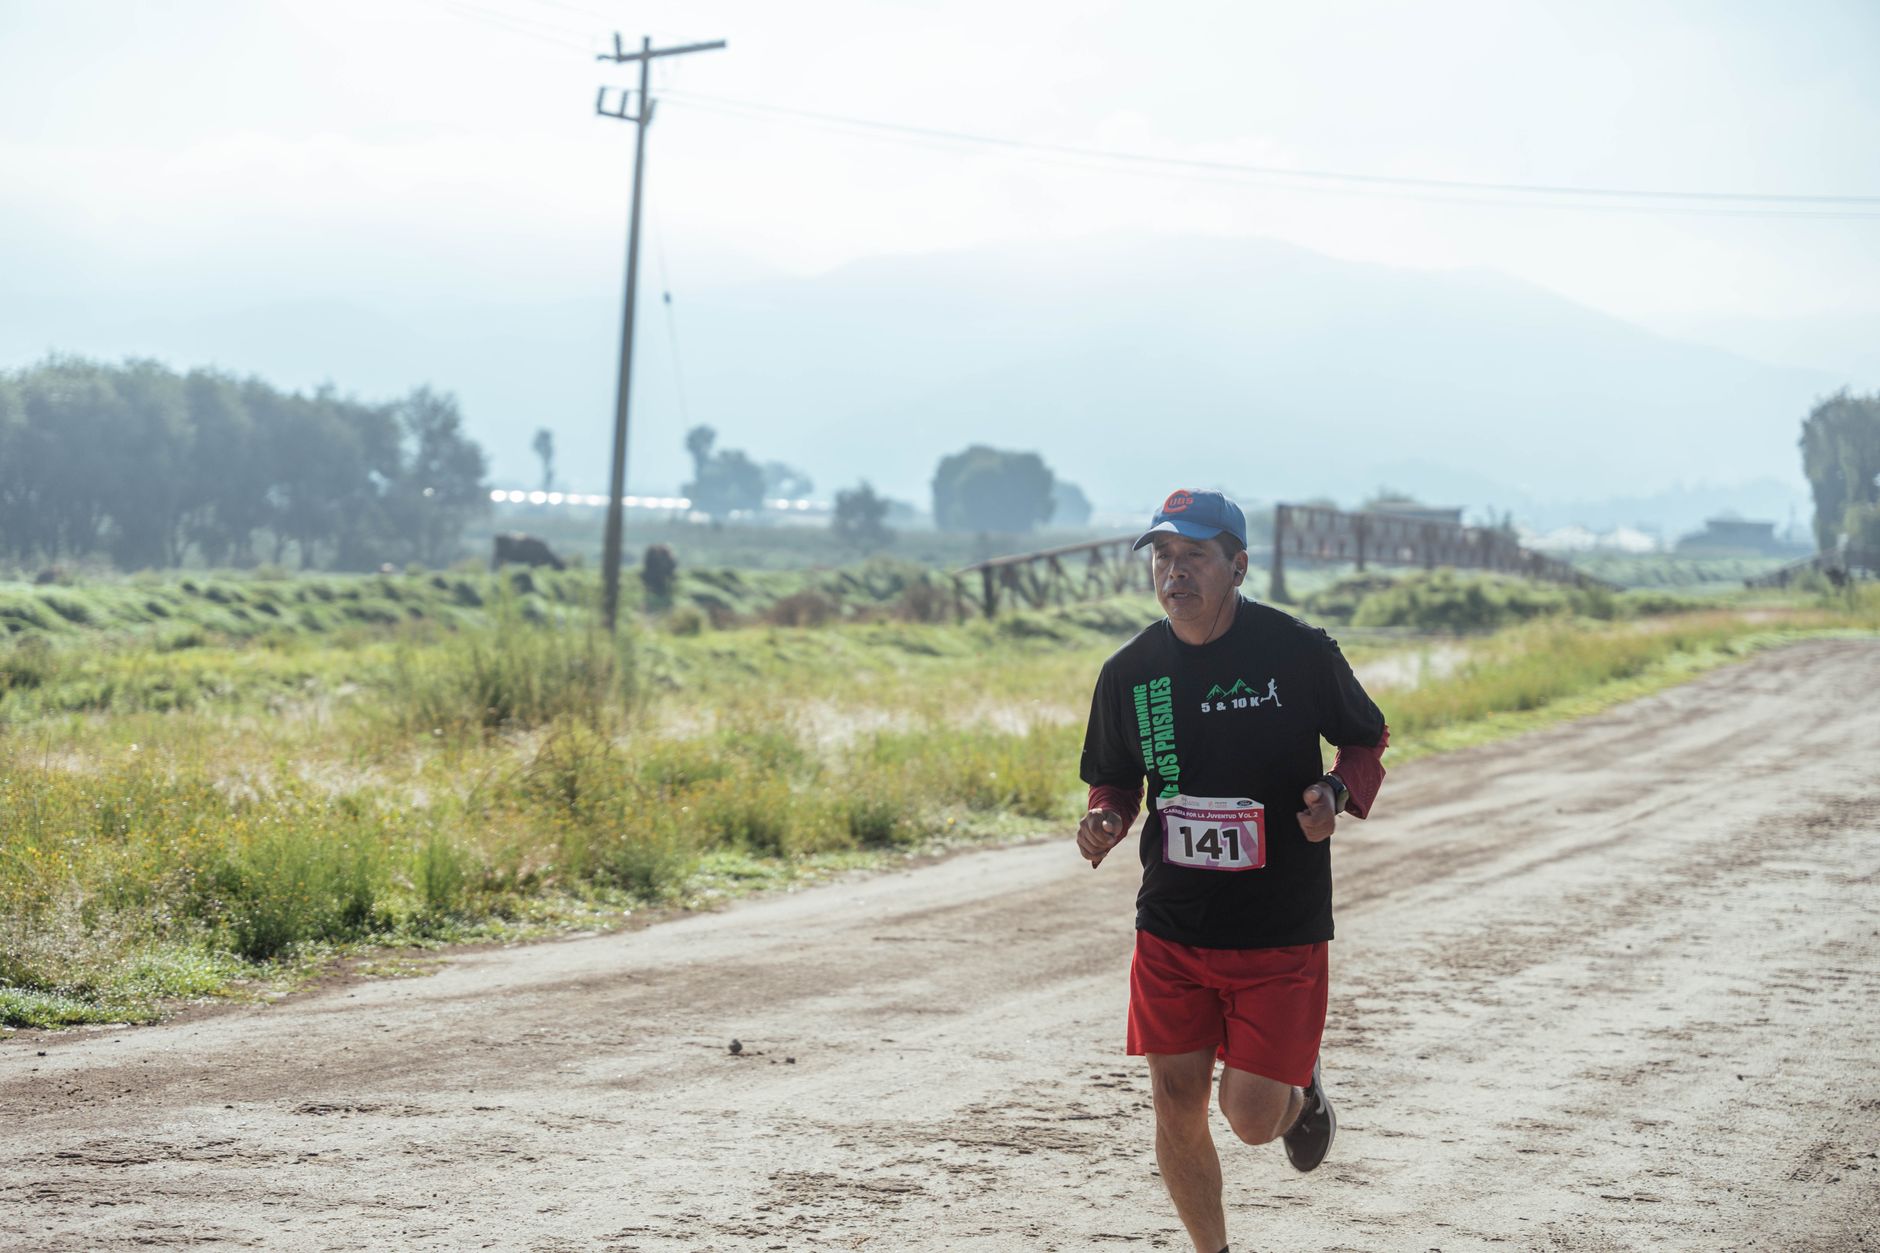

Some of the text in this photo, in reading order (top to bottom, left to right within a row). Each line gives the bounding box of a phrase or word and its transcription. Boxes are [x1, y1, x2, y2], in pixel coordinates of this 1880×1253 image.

[1149, 676, 1176, 752] PAISAJES
[1200, 696, 1260, 713] 5 & 10 K
[1133, 684, 1155, 771] TRAIL RUNNING
[1156, 753, 1180, 781] LOS
[1179, 826, 1239, 860] 141
